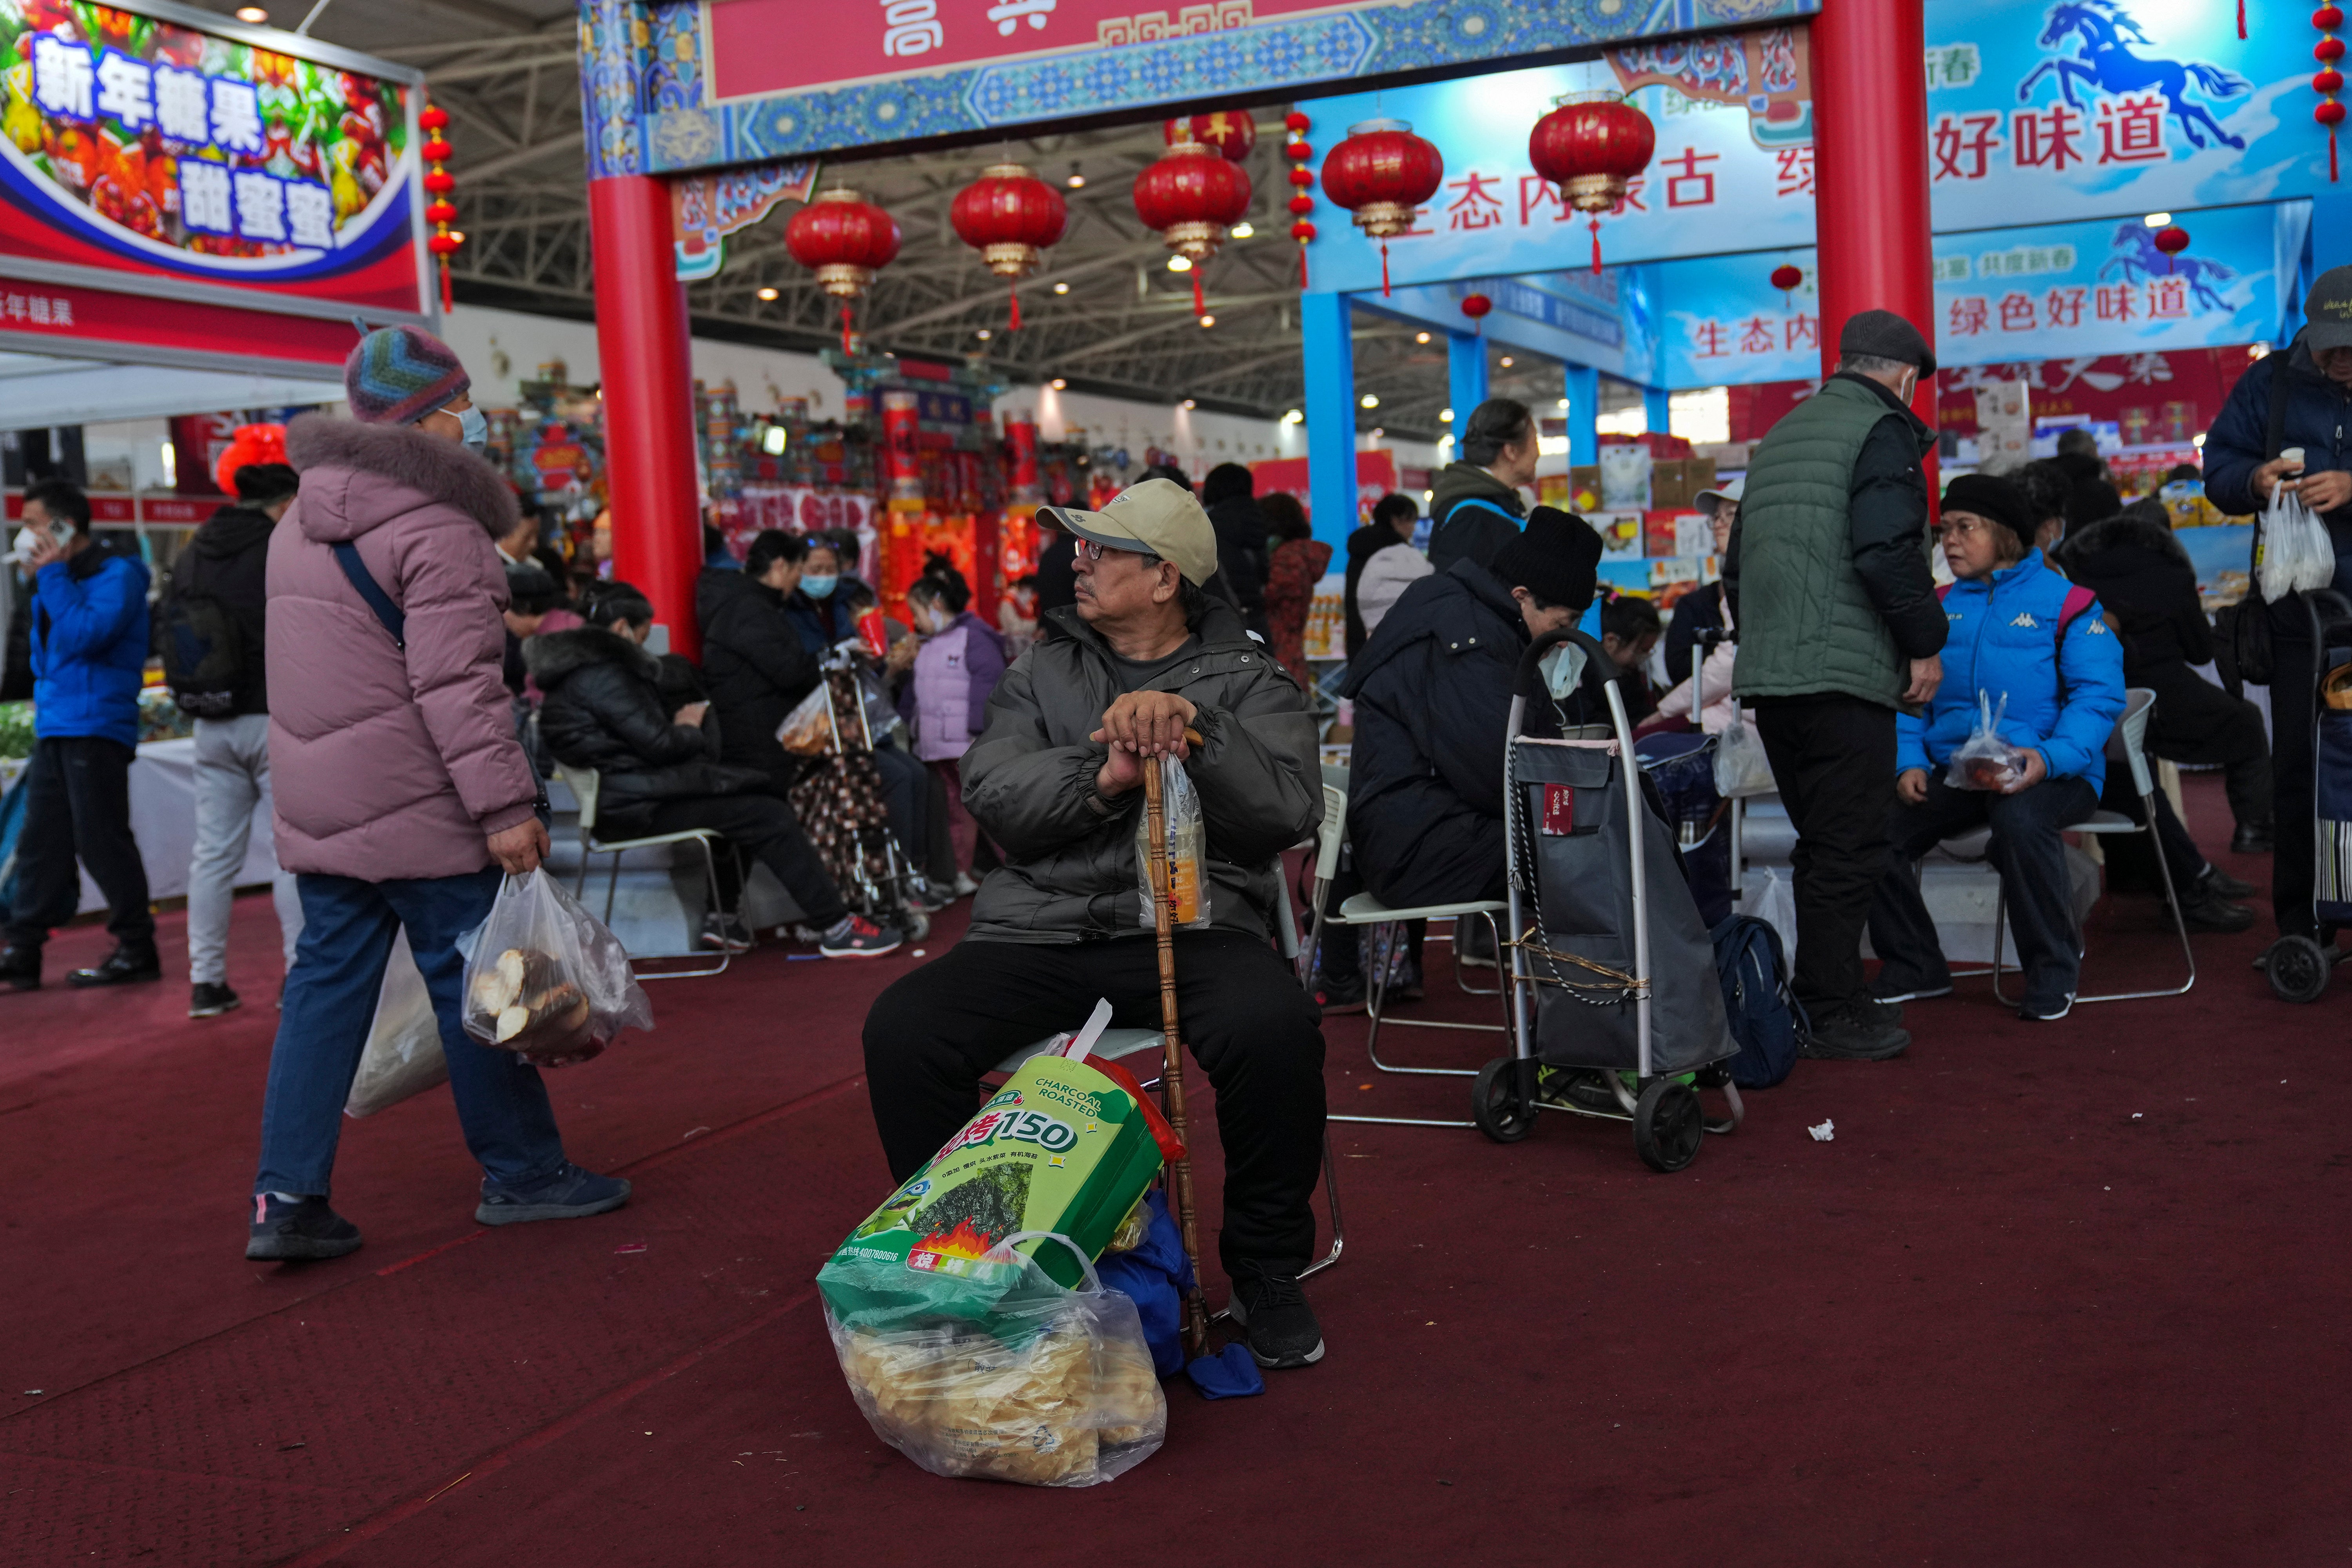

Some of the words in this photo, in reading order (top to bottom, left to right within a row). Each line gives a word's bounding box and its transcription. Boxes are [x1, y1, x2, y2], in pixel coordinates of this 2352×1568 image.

[34, 38, 263, 154] 新年糖果
[180, 162, 333, 249] 甜蜜蜜
[1949, 280, 2190, 337] 绿色好味道
[1036, 1078, 1101, 1110] CHARCOAL
[1038, 1088, 1096, 1117] ROASTED
[980, 1152, 1006, 1164] 头水紫菜
[1011, 1151, 1038, 1160] 有机海苔
